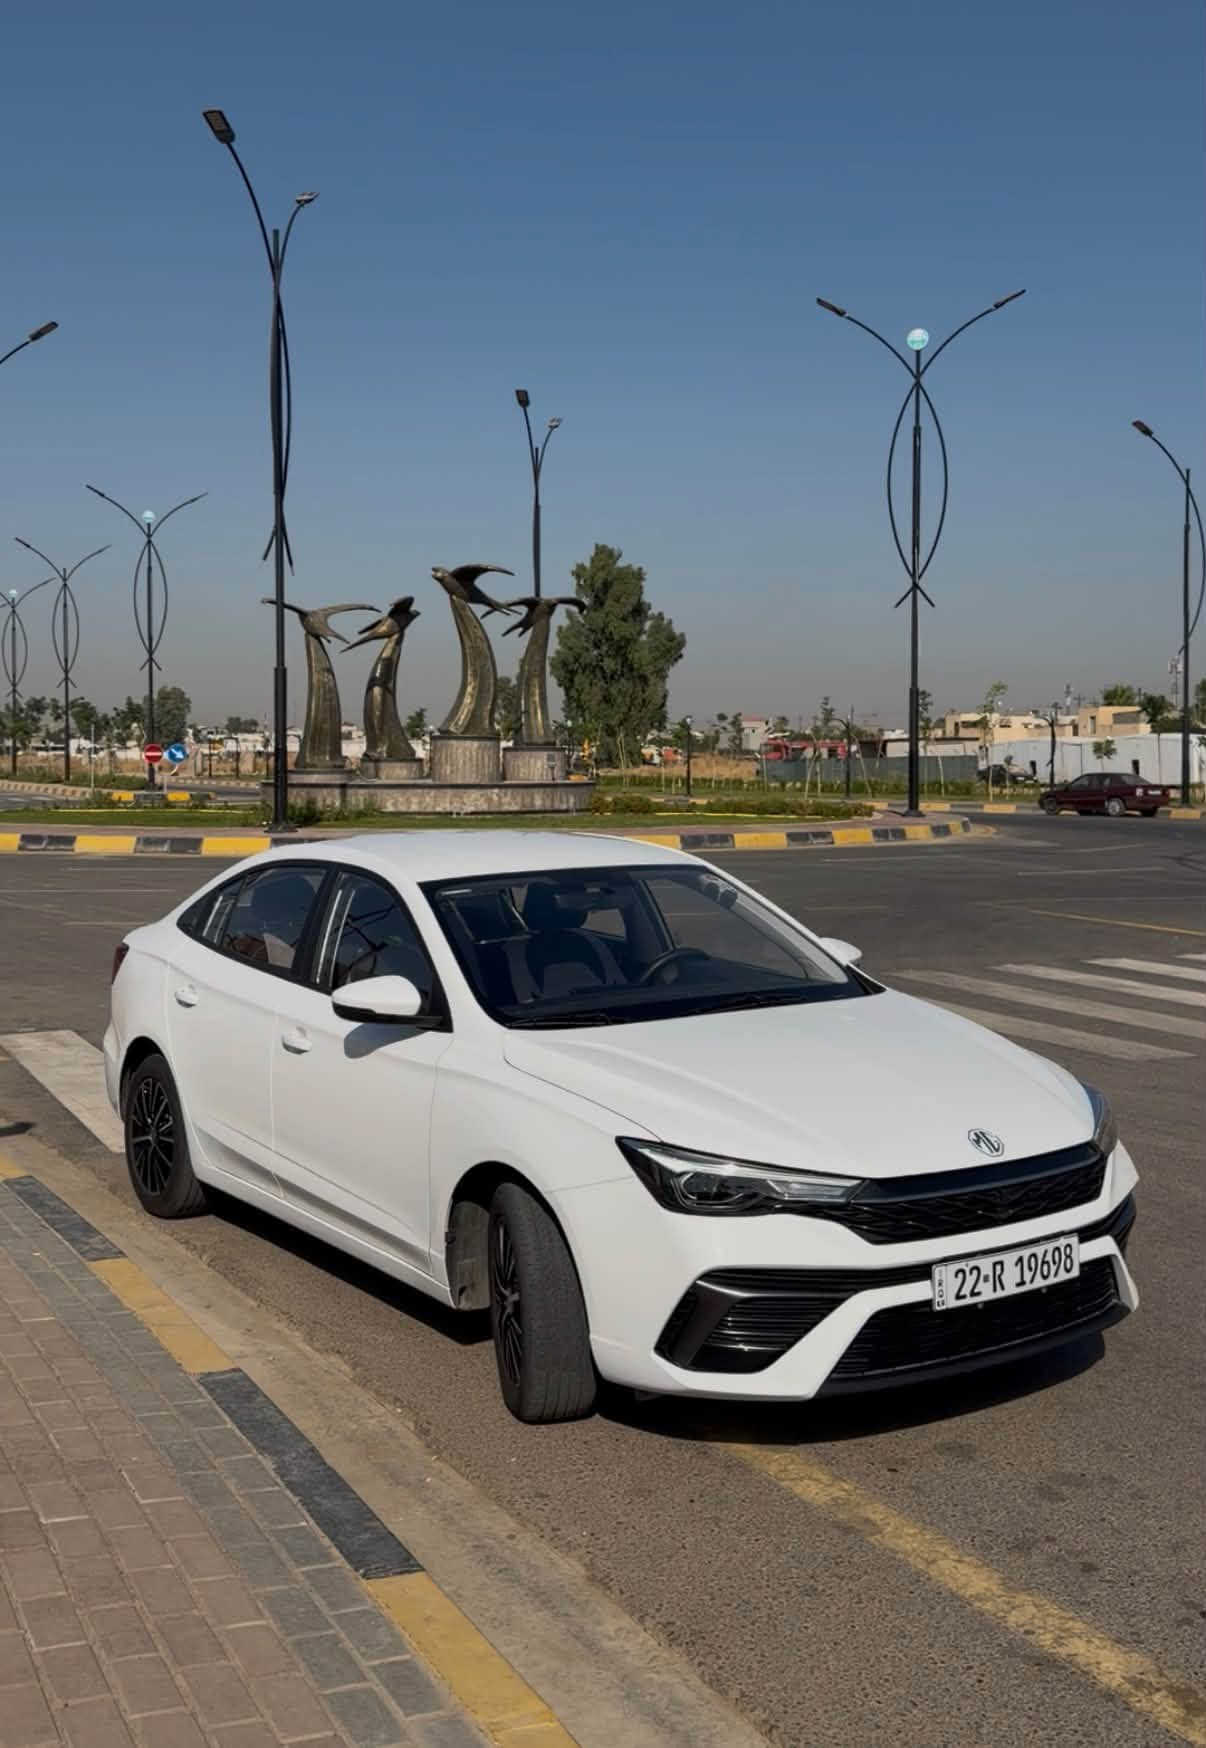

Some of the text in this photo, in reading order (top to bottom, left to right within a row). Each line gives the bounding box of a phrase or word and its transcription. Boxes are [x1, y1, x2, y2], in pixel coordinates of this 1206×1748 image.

[968, 1128, 1002, 1154] MG
[954, 1243, 1074, 1301] 22-R 19698
